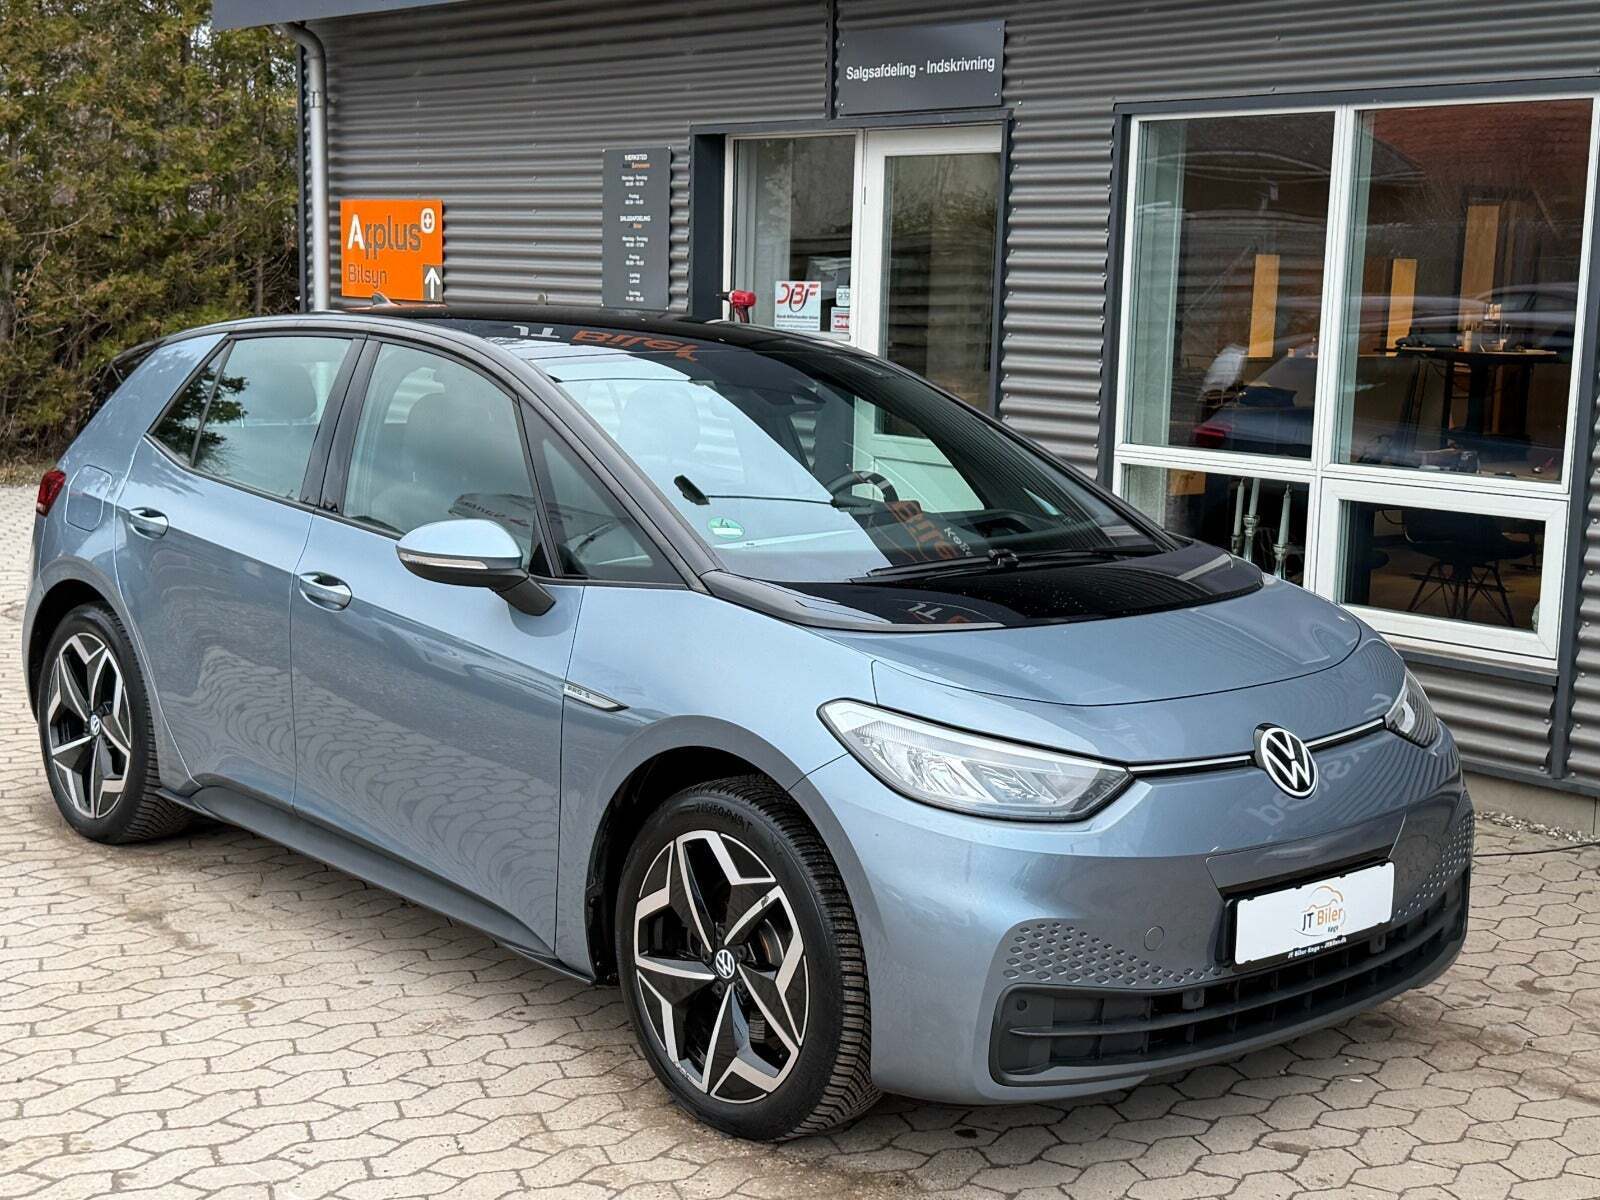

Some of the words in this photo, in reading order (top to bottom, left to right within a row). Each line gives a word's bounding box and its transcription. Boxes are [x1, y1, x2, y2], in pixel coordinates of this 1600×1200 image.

[846, 63, 917, 82] Salgsafdeling
[926, 56, 996, 74] Indskrivning
[348, 264, 388, 289] Bilsyn
[1302, 912, 1314, 931] JT
[1317, 907, 1344, 926] Biler
